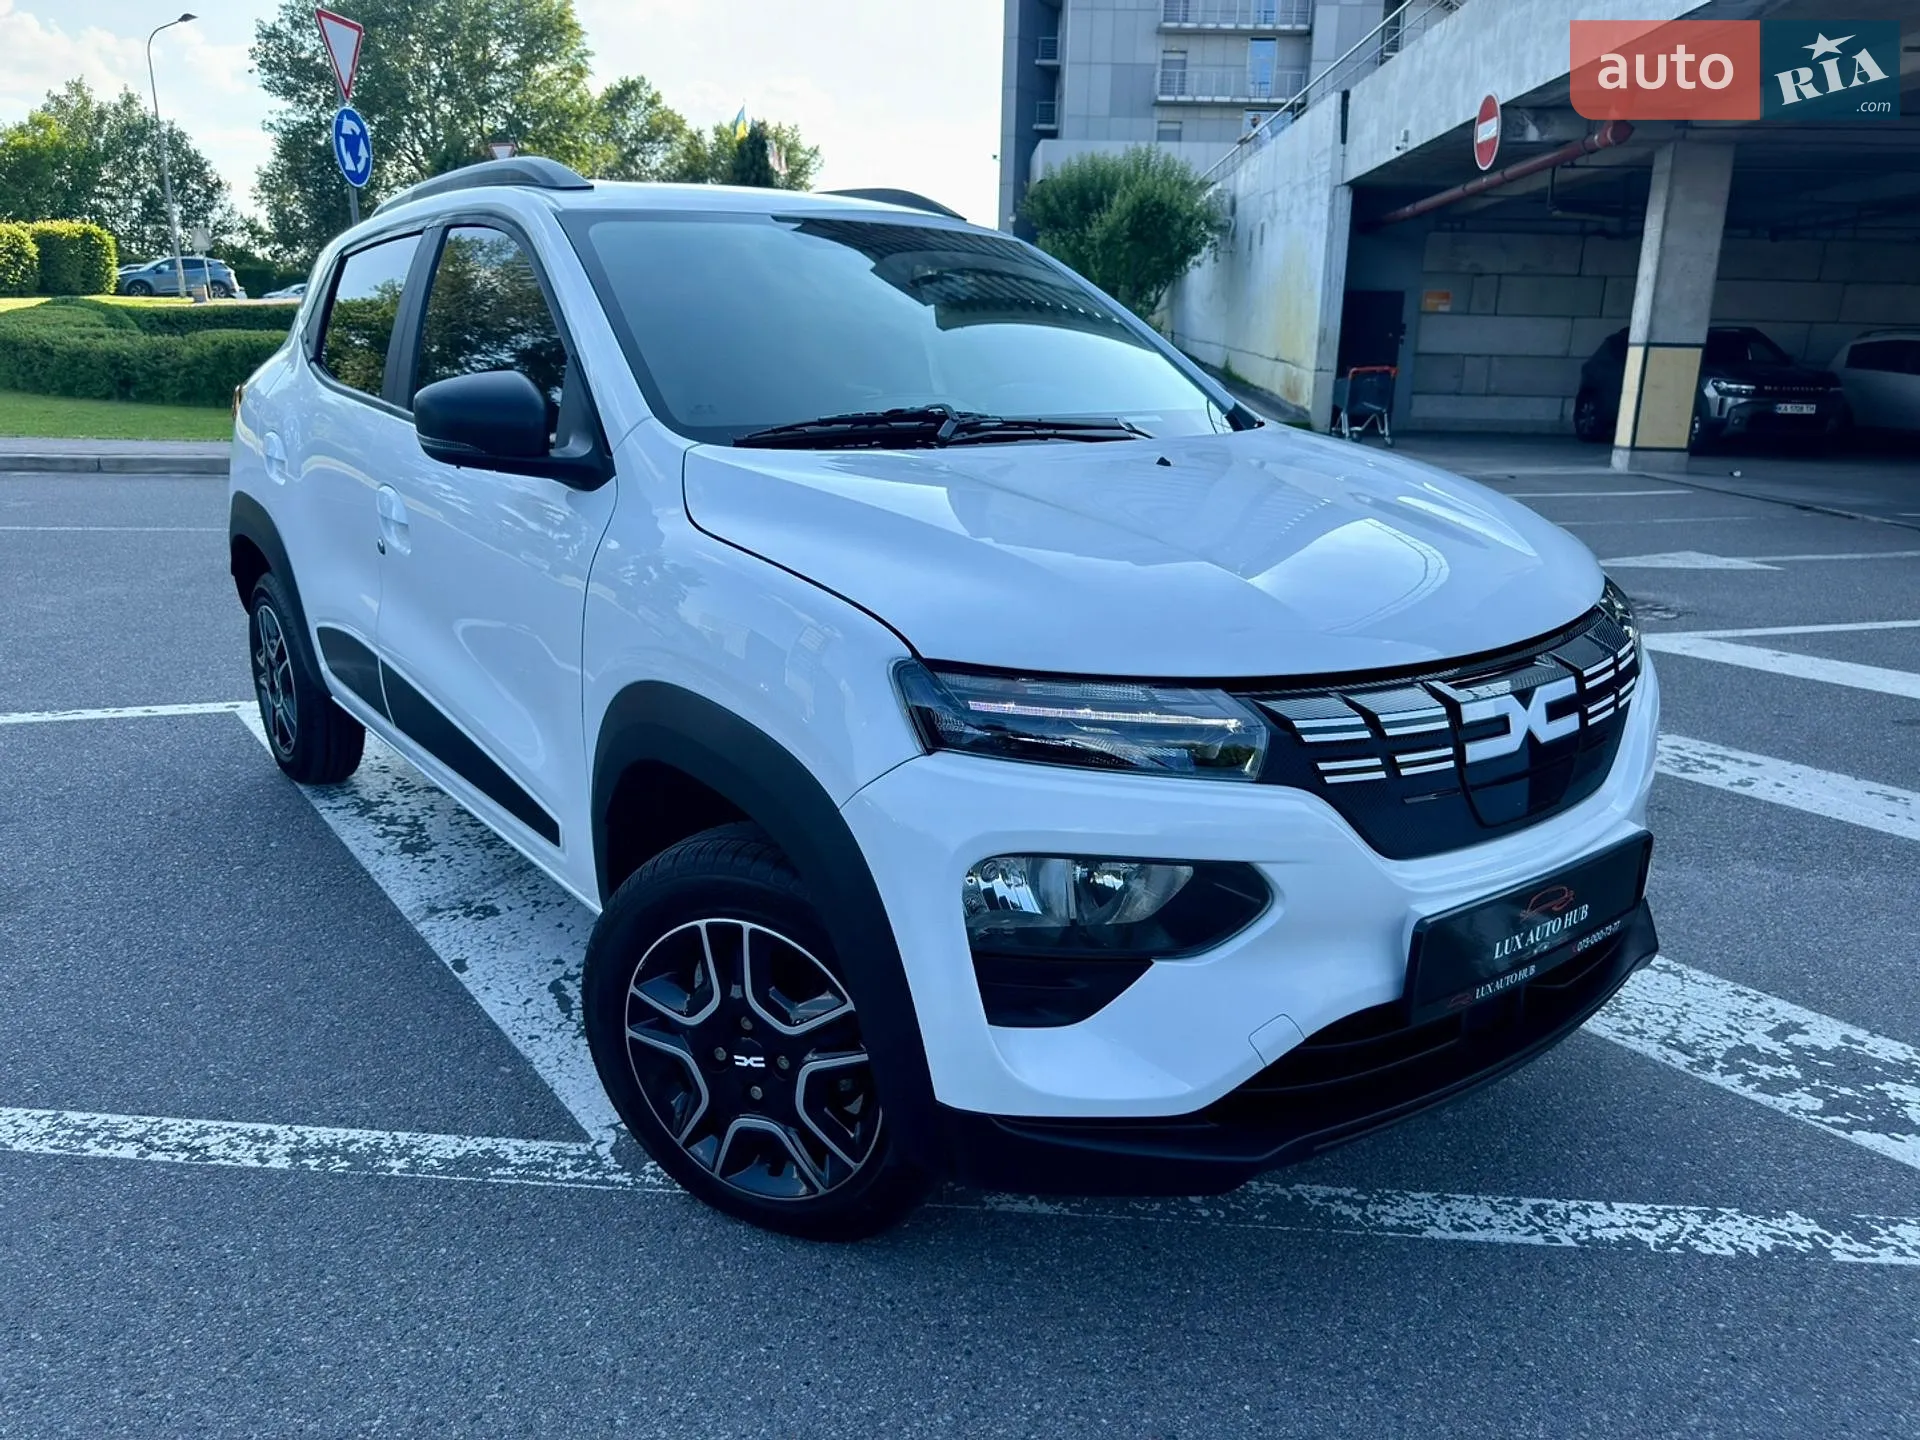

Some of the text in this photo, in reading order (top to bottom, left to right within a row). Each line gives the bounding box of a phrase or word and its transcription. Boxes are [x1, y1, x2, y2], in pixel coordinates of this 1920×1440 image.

[1493, 903, 1589, 960] LUX AUTO HUB
